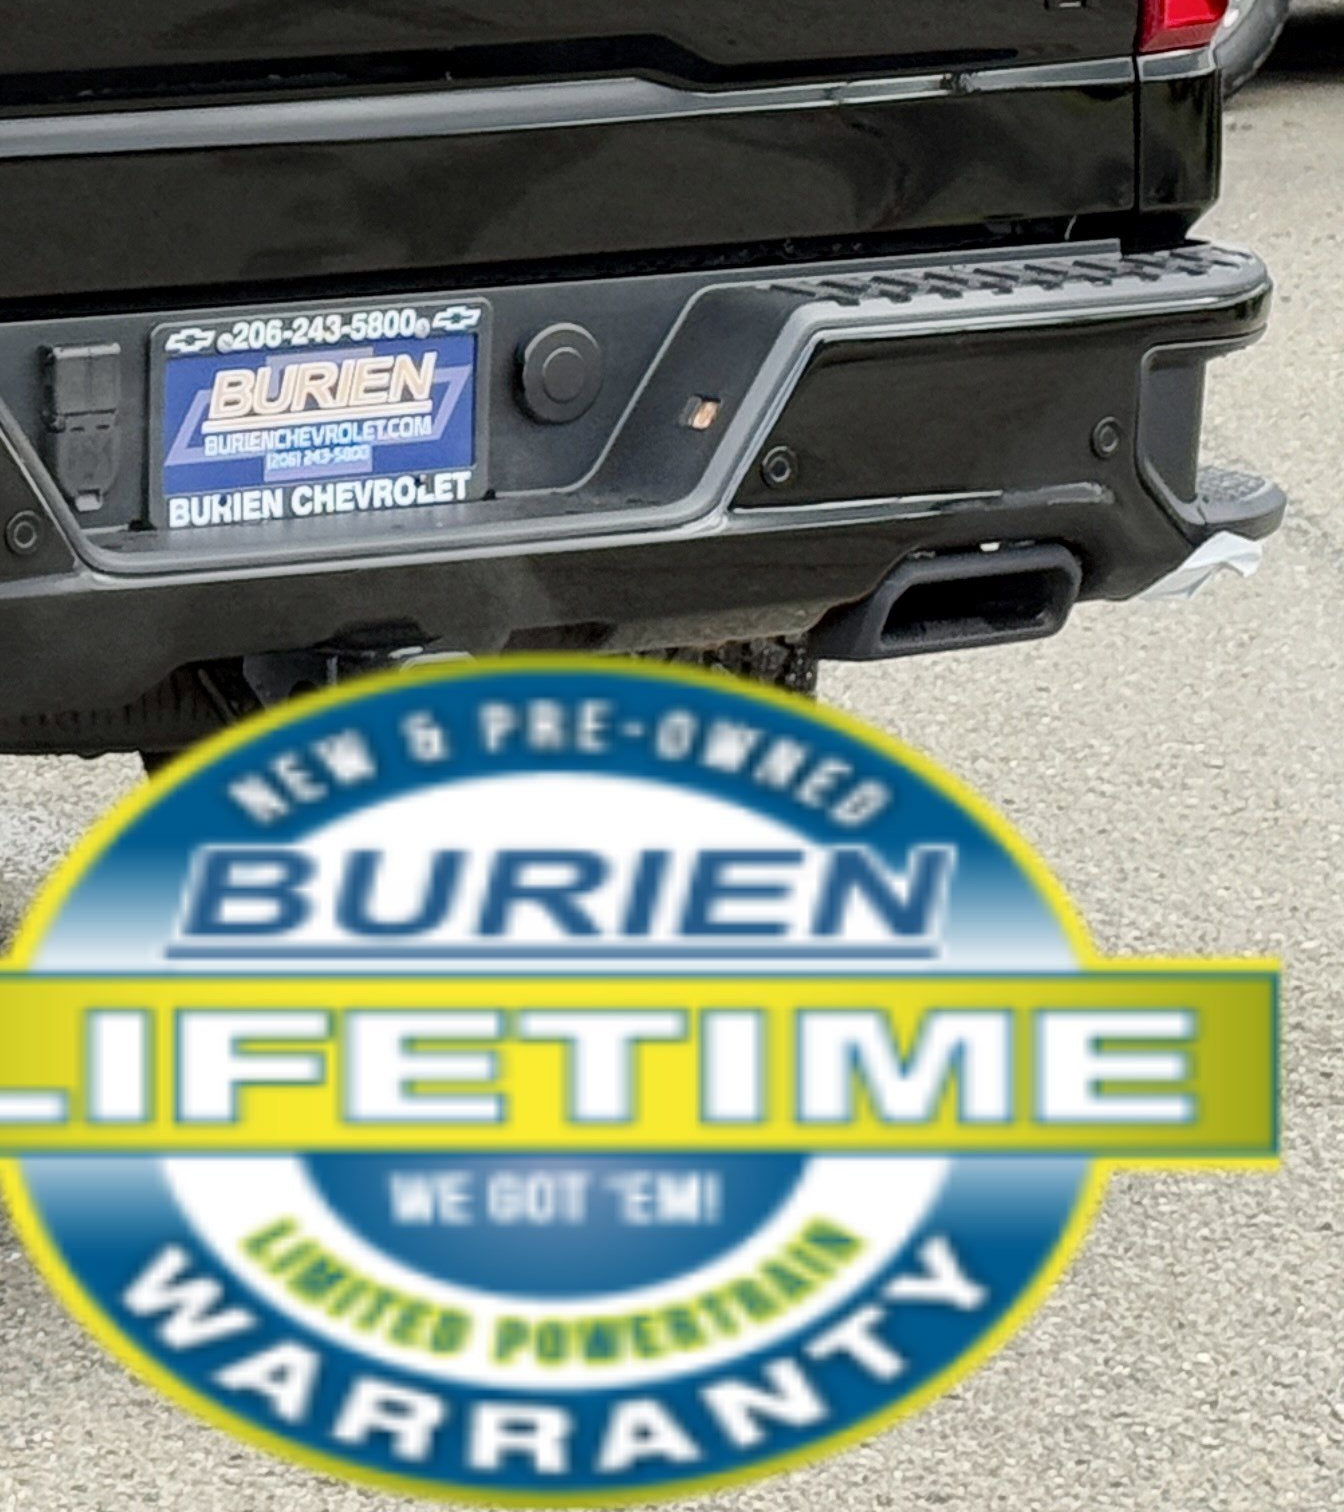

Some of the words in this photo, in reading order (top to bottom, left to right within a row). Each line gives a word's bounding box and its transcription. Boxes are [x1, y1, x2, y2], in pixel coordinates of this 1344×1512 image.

[230, 309, 416, 351] 206-243-5800
[210, 351, 437, 419] BURIEN
[204, 416, 432, 457] BURIENCHEVROLET.COM
[169, 488, 283, 528] BURIEN
[291, 472, 472, 517] CHEVROLET
